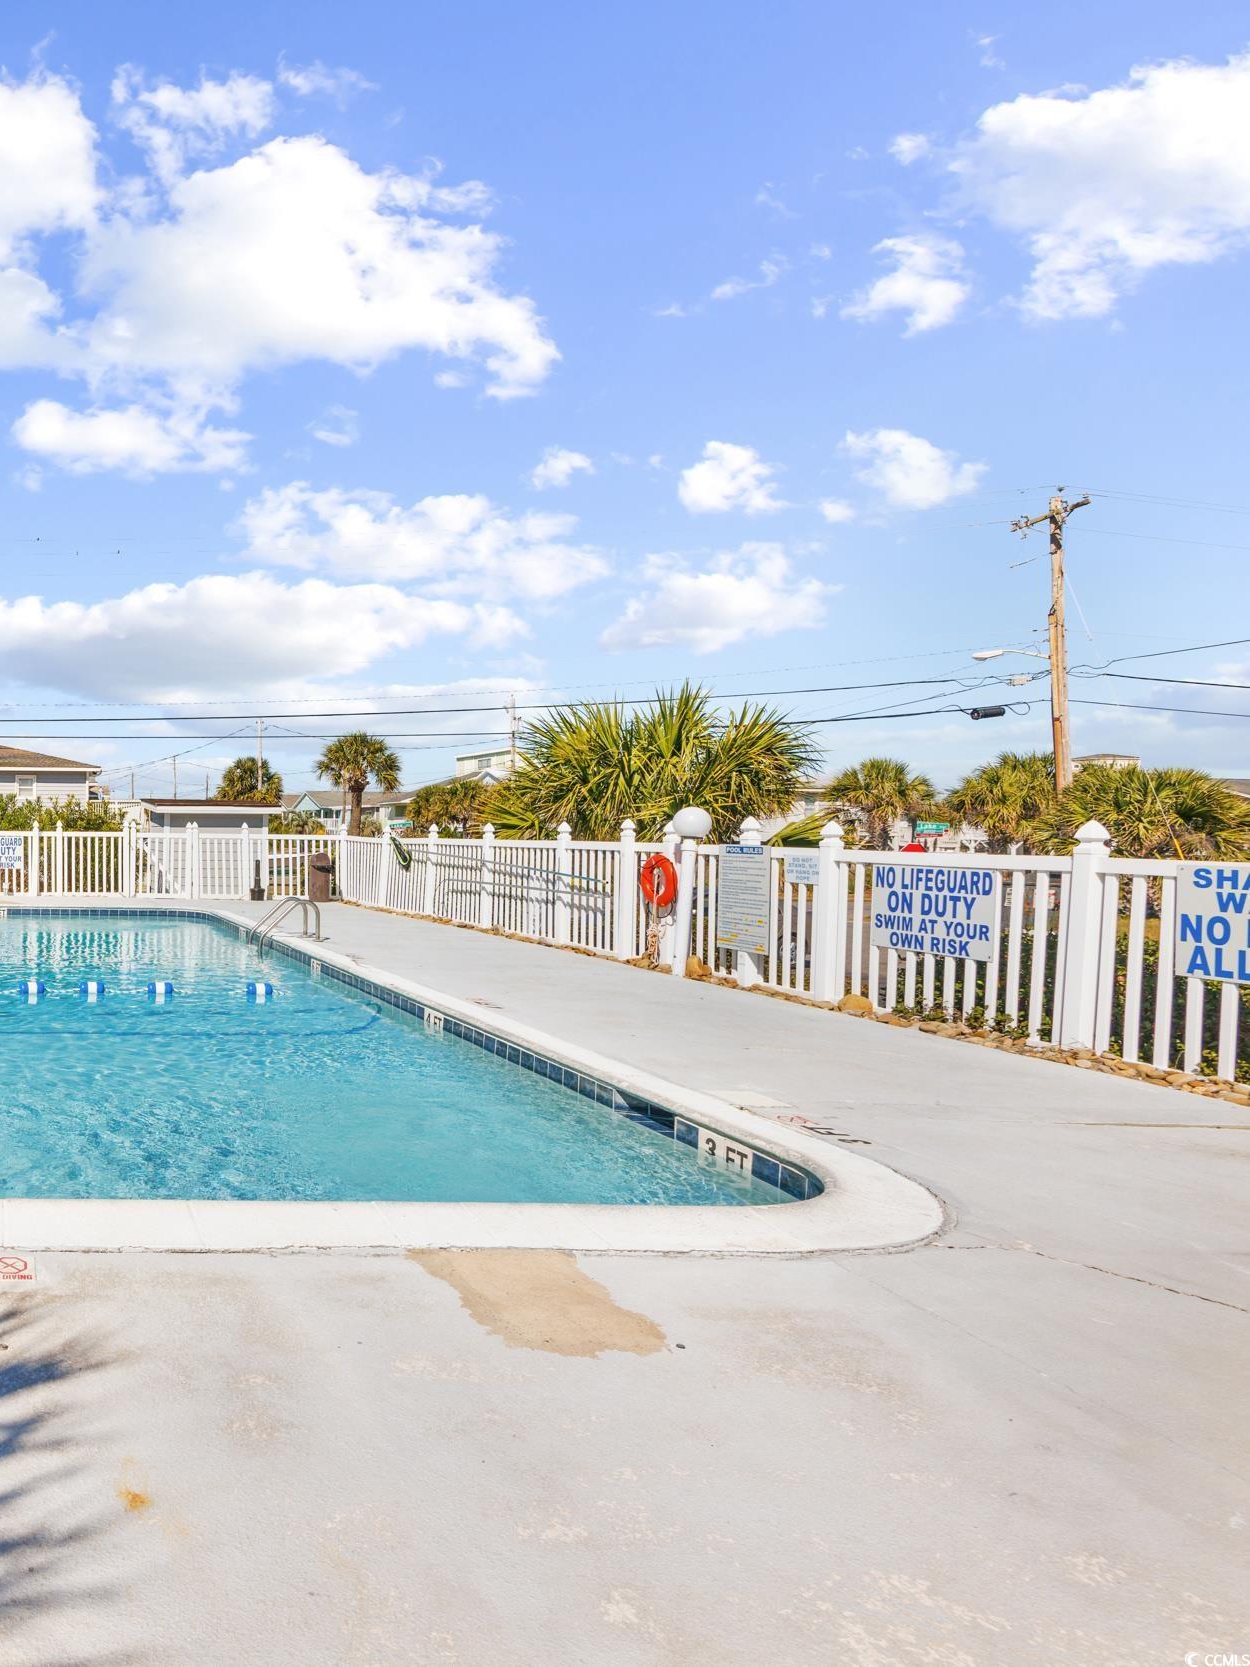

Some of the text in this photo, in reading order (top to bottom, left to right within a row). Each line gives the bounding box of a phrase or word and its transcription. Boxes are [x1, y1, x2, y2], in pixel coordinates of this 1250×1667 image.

[875, 866, 993, 896] NO LIFEGUARD
[887, 891, 913, 914] ON
[921, 893, 977, 920] DUTY
[875, 913, 990, 942] SWIM AT YOUR
[1180, 914, 1230, 946] NO
[890, 931, 970, 957] OWN RISK
[705, 1138, 748, 1170] 3 FT
